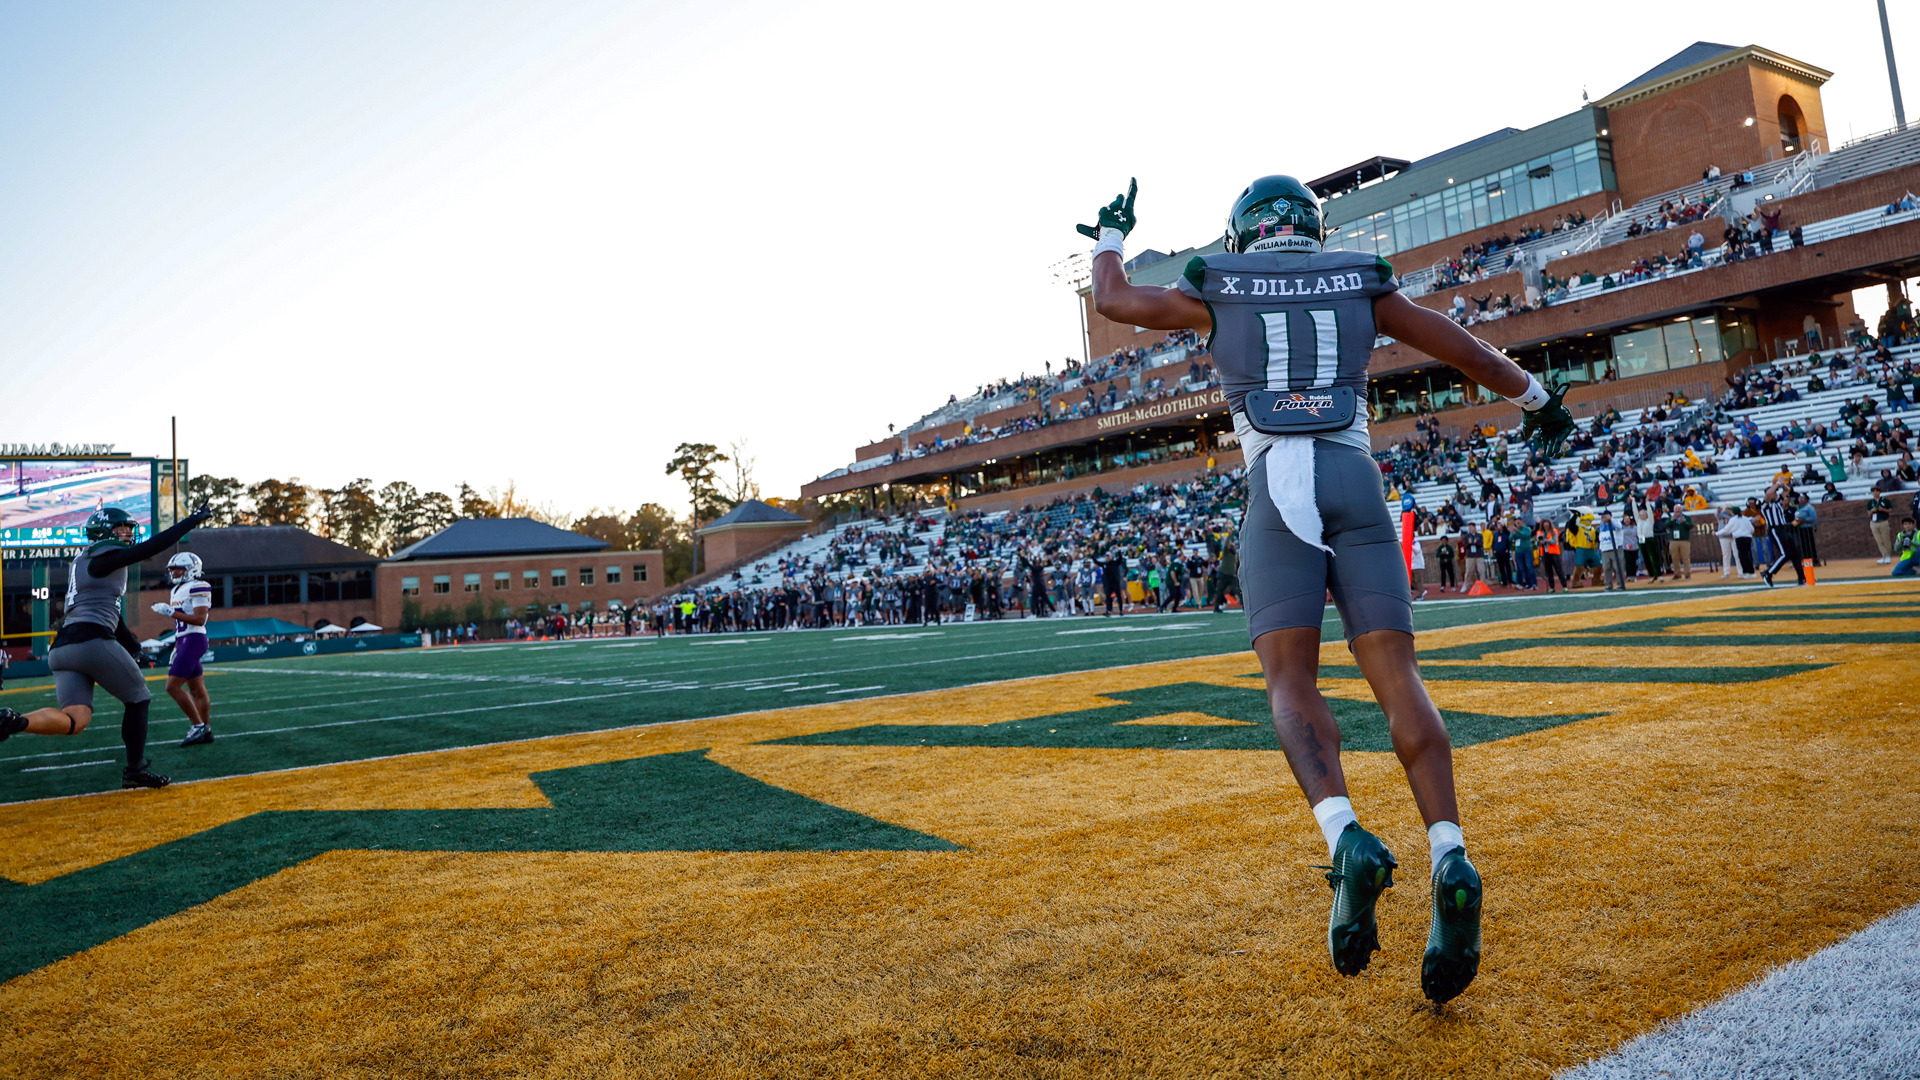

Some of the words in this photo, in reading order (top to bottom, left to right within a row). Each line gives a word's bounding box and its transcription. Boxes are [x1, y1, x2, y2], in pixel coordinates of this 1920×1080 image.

[1290, 213, 1299, 225] 11
[1254, 240, 1287, 251] WILLIAM
[1287, 238, 1294, 248] &
[1293, 239, 1313, 248] MARY
[1220, 276, 1245, 295] X.
[1250, 272, 1363, 296] DILLARD
[1256, 309, 1340, 392] 11
[0, 443, 47, 456] LIAM
[65, 442, 116, 456] MARY
[29, 548, 61, 559] ZABLE
[63, 547, 84, 557] STA
[31, 587, 49, 600] 40
